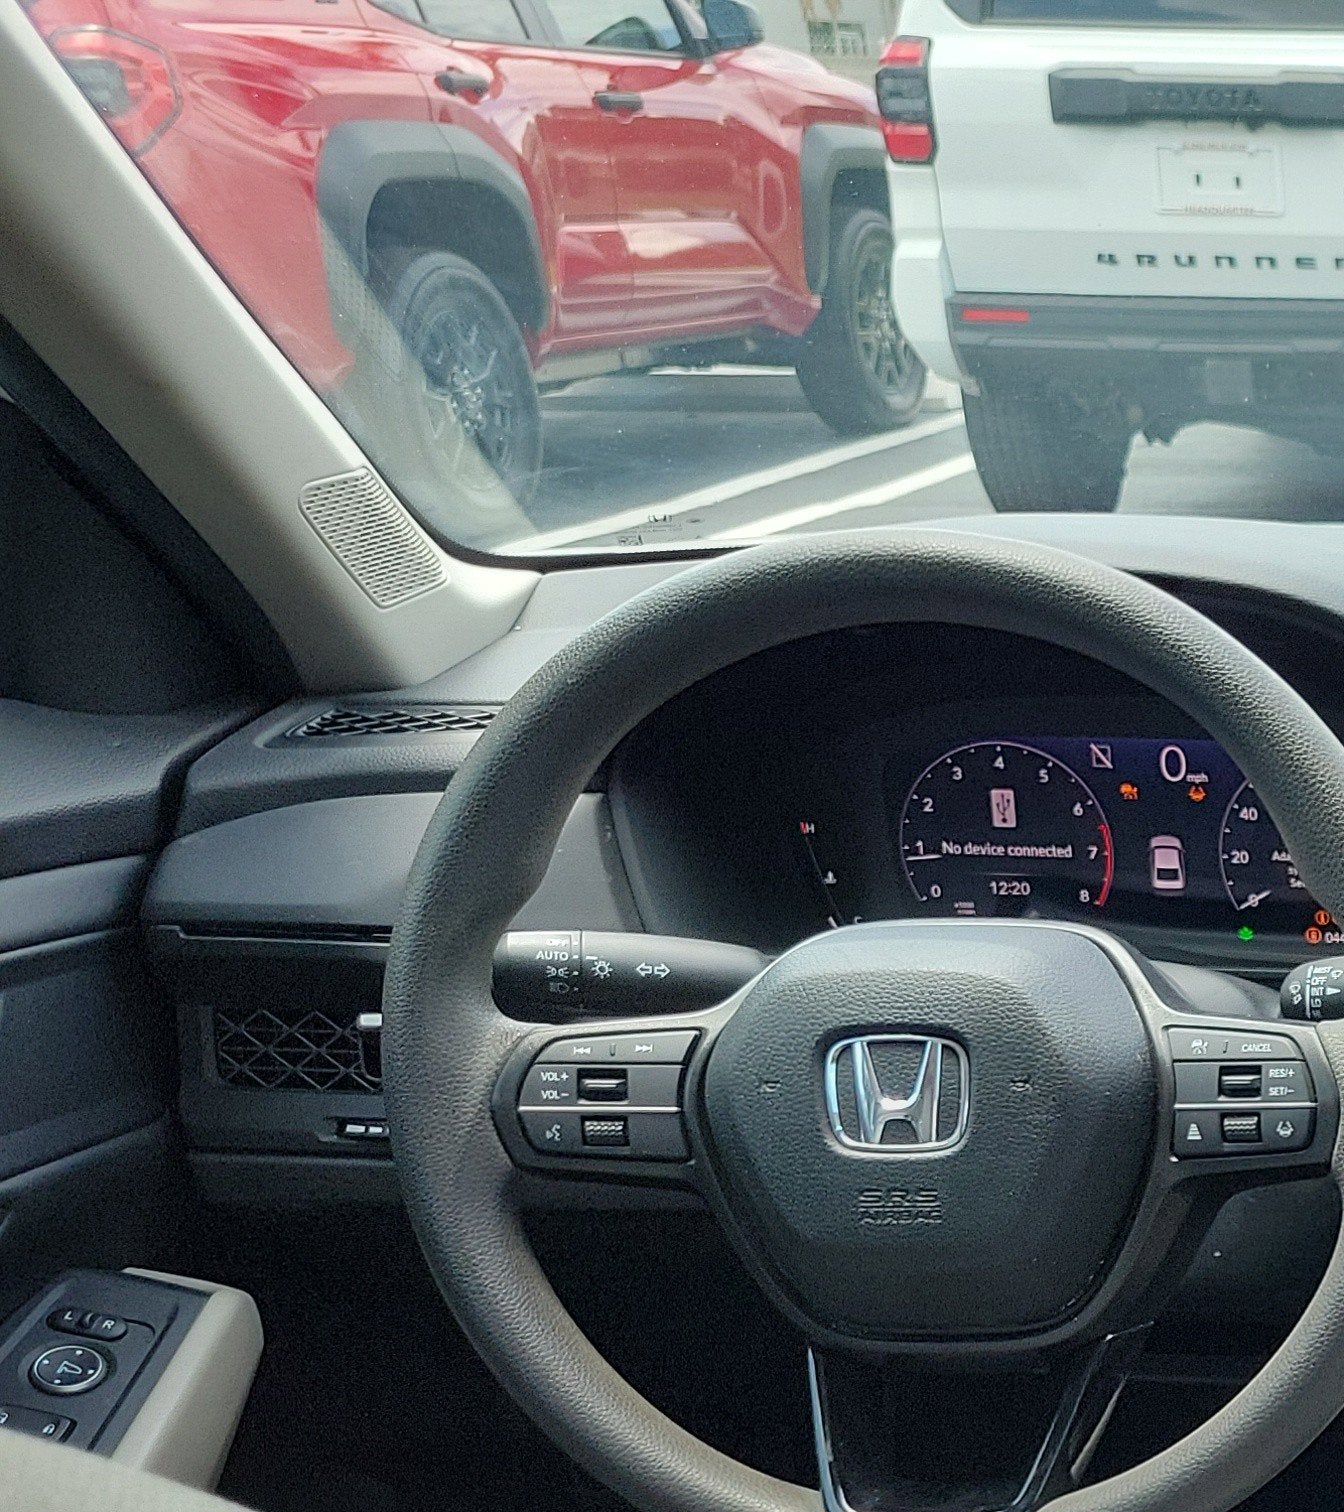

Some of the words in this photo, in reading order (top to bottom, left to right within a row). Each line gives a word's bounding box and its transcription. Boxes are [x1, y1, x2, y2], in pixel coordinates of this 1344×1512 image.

[993, 756, 1005, 769] 4
[1159, 744, 1187, 782] 0
[1186, 772, 1209, 784] mph
[952, 767, 963, 780] 3
[1038, 769, 1049, 783] 5
[922, 798, 934, 813] 2
[1072, 802, 1084, 817] 6
[1239, 807, 1259, 821] 40
[915, 840, 924, 854] 1
[941, 841, 961, 855] No
[963, 842, 1005, 856] device
[1007, 844, 1073, 858] connected
[1087, 846, 1098, 860] 7
[1230, 849, 1250, 865] 20
[930, 884, 942, 898] 0
[989, 881, 1031, 896] 12:20
[1079, 889, 1090, 903] 8
[535, 950, 569, 961] AUTO
[1311, 977, 1327, 986] OFF
[1241, 1043, 1272, 1053] CANCEL
[64, 1310, 73, 1320] L
[102, 1320, 115, 1330] R
